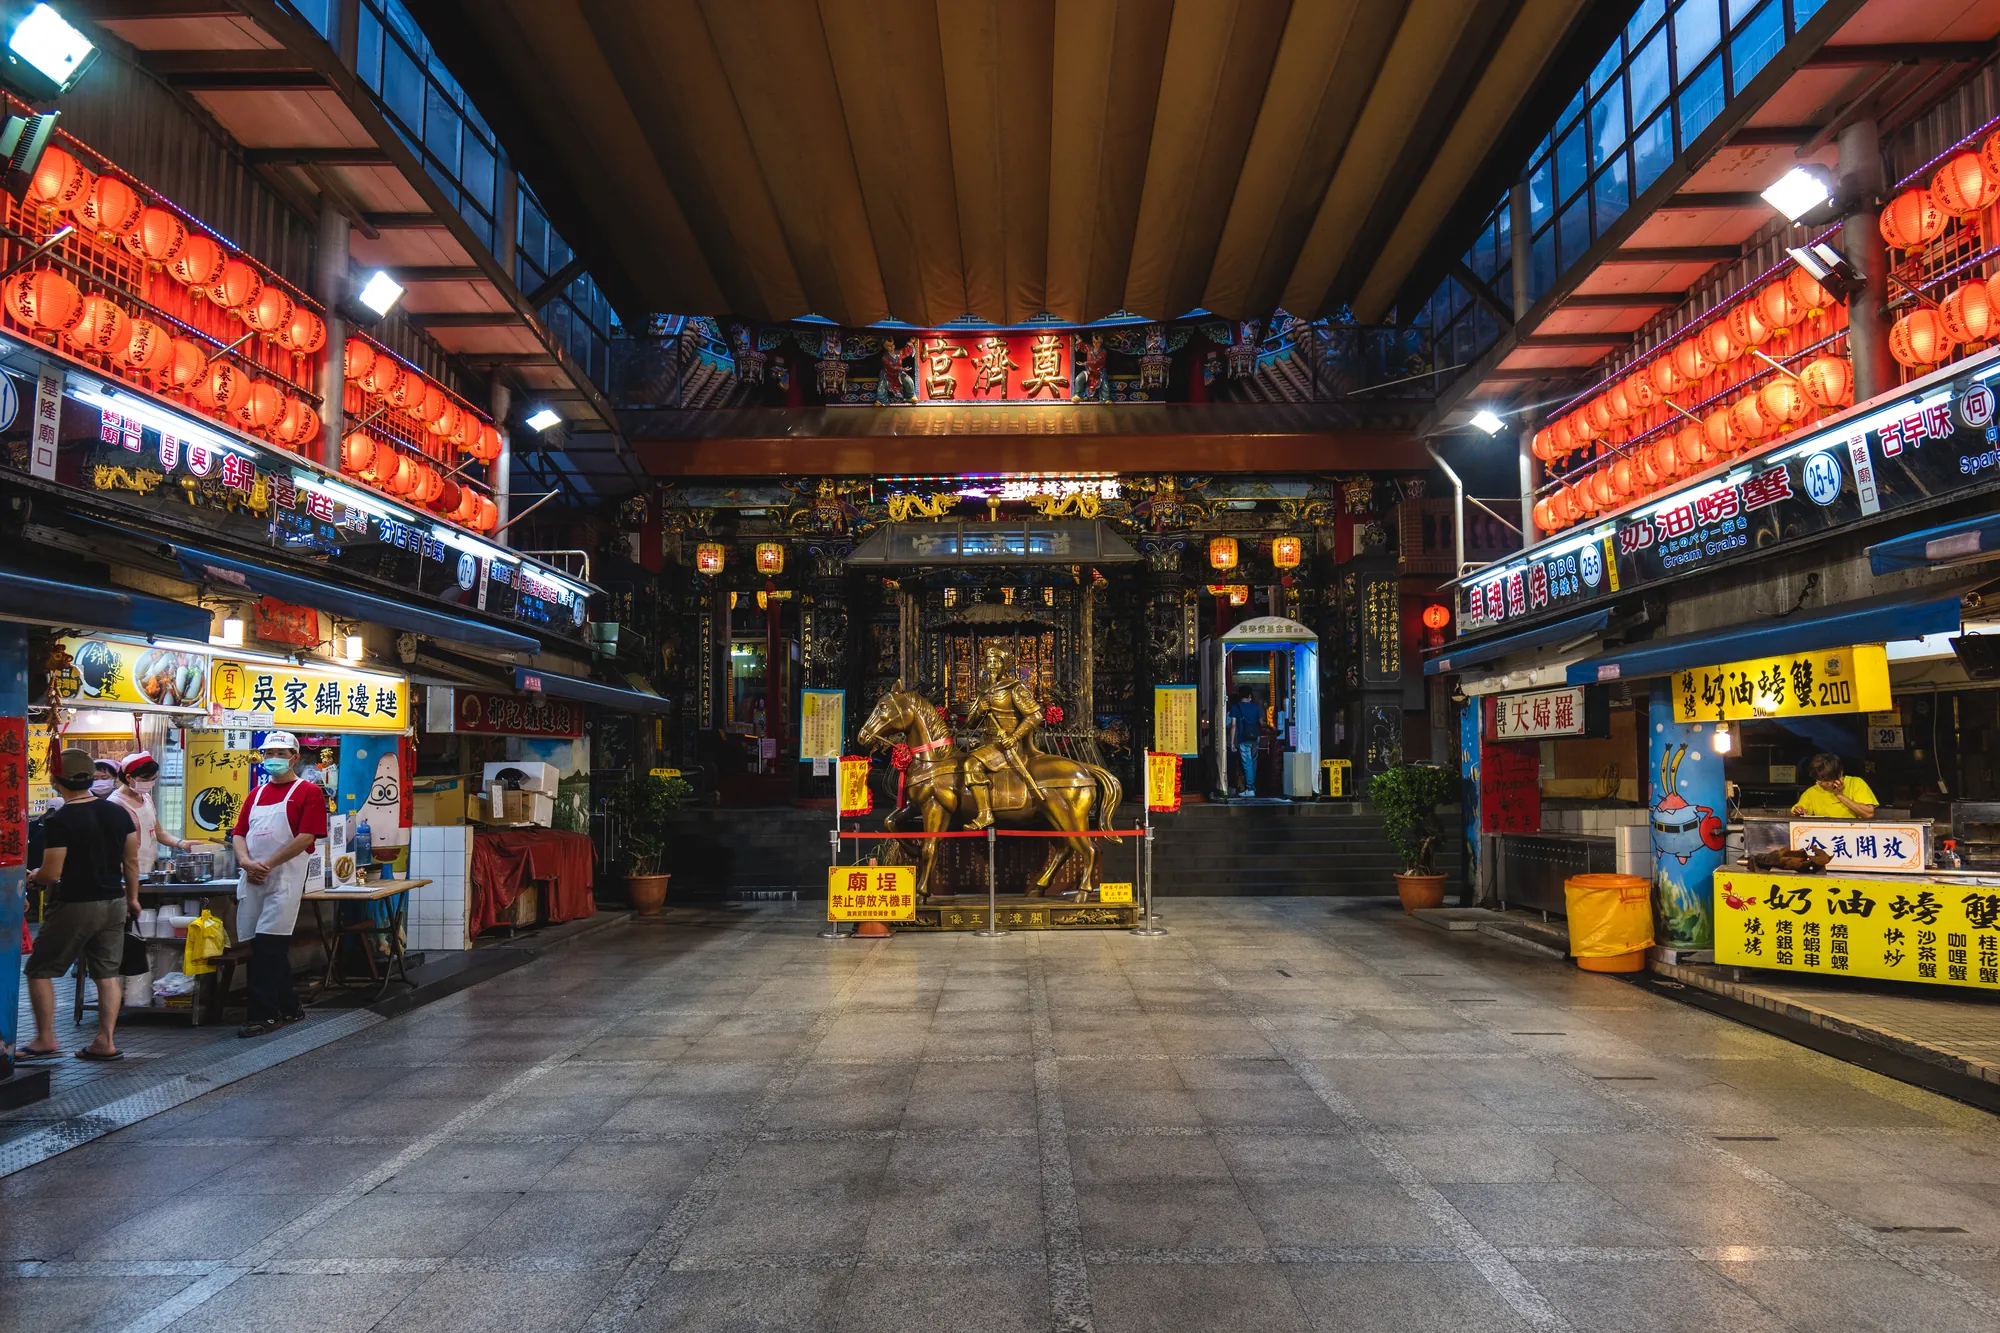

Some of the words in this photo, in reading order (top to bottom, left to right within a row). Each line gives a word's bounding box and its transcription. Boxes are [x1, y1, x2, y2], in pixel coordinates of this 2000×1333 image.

[920, 335, 1071, 400] 奠濟宮
[37, 375, 60, 468] 基隆廟口
[1966, 391, 1987, 421] 何
[1879, 403, 1953, 458] 古早味
[1809, 460, 1836, 498] 25-4
[1619, 464, 1793, 555] 奶油螃蟹
[379, 517, 446, 563] 分店有冷氣
[1663, 547, 1703, 569] Cream
[1705, 533, 1748, 556] Crabs
[1550, 556, 1577, 580] BBQ
[1582, 554, 1600, 577] 25-5
[1470, 563, 1549, 627] 串魂燒烤
[1550, 575, 1579, 600] 串焼き
[222, 668, 238, 707] 百年
[1701, 659, 1816, 709] 奶油螃蟹
[1819, 680, 1851, 707] 200
[1511, 693, 1575, 733] 天婦羅
[1879, 729, 1896, 745] 29
[1804, 835, 1907, 860] 冷氣開放
[832, 895, 912, 908] 禁止停放汽機車
[847, 872, 897, 892] 廟埕
[1763, 884, 2000, 930] 奶油螃蟹
[1744, 917, 1765, 957] 燒烤
[1775, 919, 1794, 965] 烤銀蛤
[1802, 921, 1821, 967] 烤蝦串
[1830, 923, 1849, 971] 燒風螺
[1883, 927, 1905, 968] 快炒
[1917, 930, 1937, 979] 沙茶蟹
[1948, 932, 1968, 981] 咖哩蟹
[1978, 934, 1999, 984] 桂花蟹
